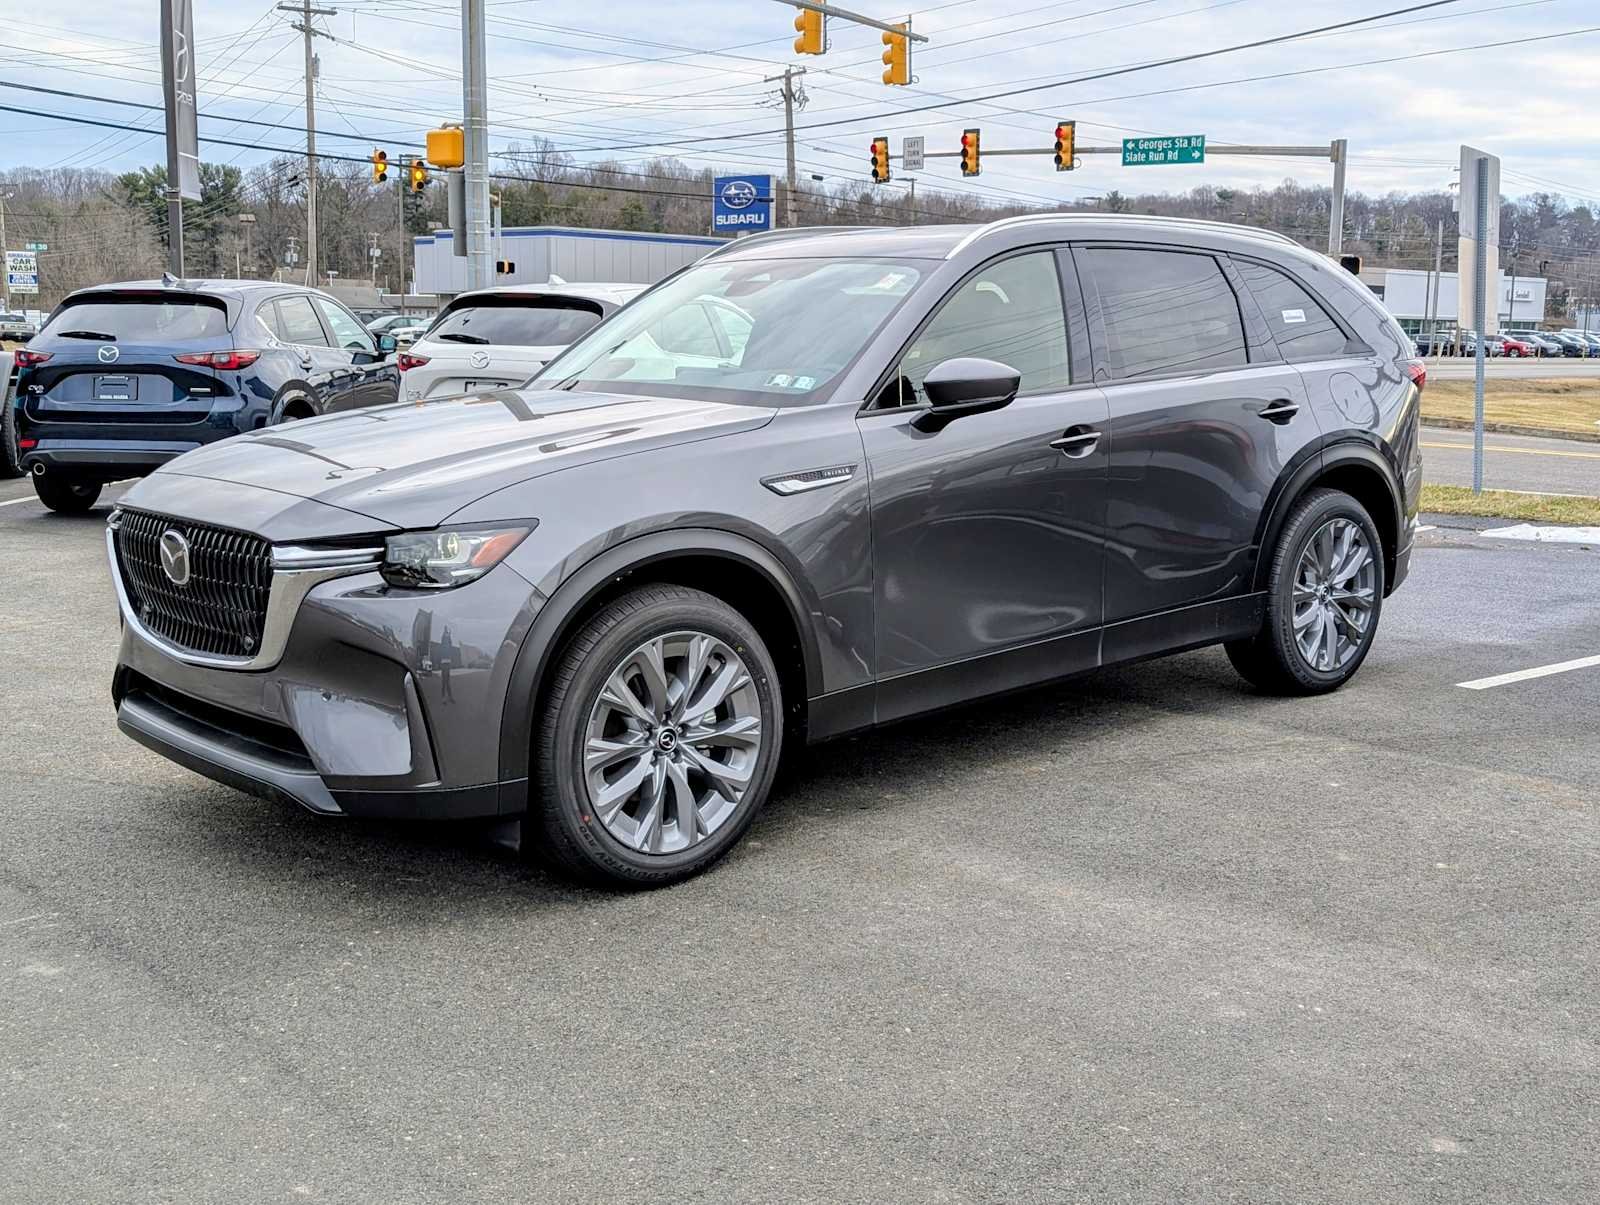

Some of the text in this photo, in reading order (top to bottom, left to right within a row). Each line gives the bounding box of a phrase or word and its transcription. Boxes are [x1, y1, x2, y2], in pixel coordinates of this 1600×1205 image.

[906, 140, 919, 148] LEFT
[1138, 137, 1202, 151] Georges Sta Rd
[906, 150, 919, 158] TURN
[1125, 150, 1179, 162] Slate Run Rd
[905, 159, 921, 167] SIGNAL
[716, 213, 765, 225] SUBARU
[593, 850, 671, 881] COUNTRY
